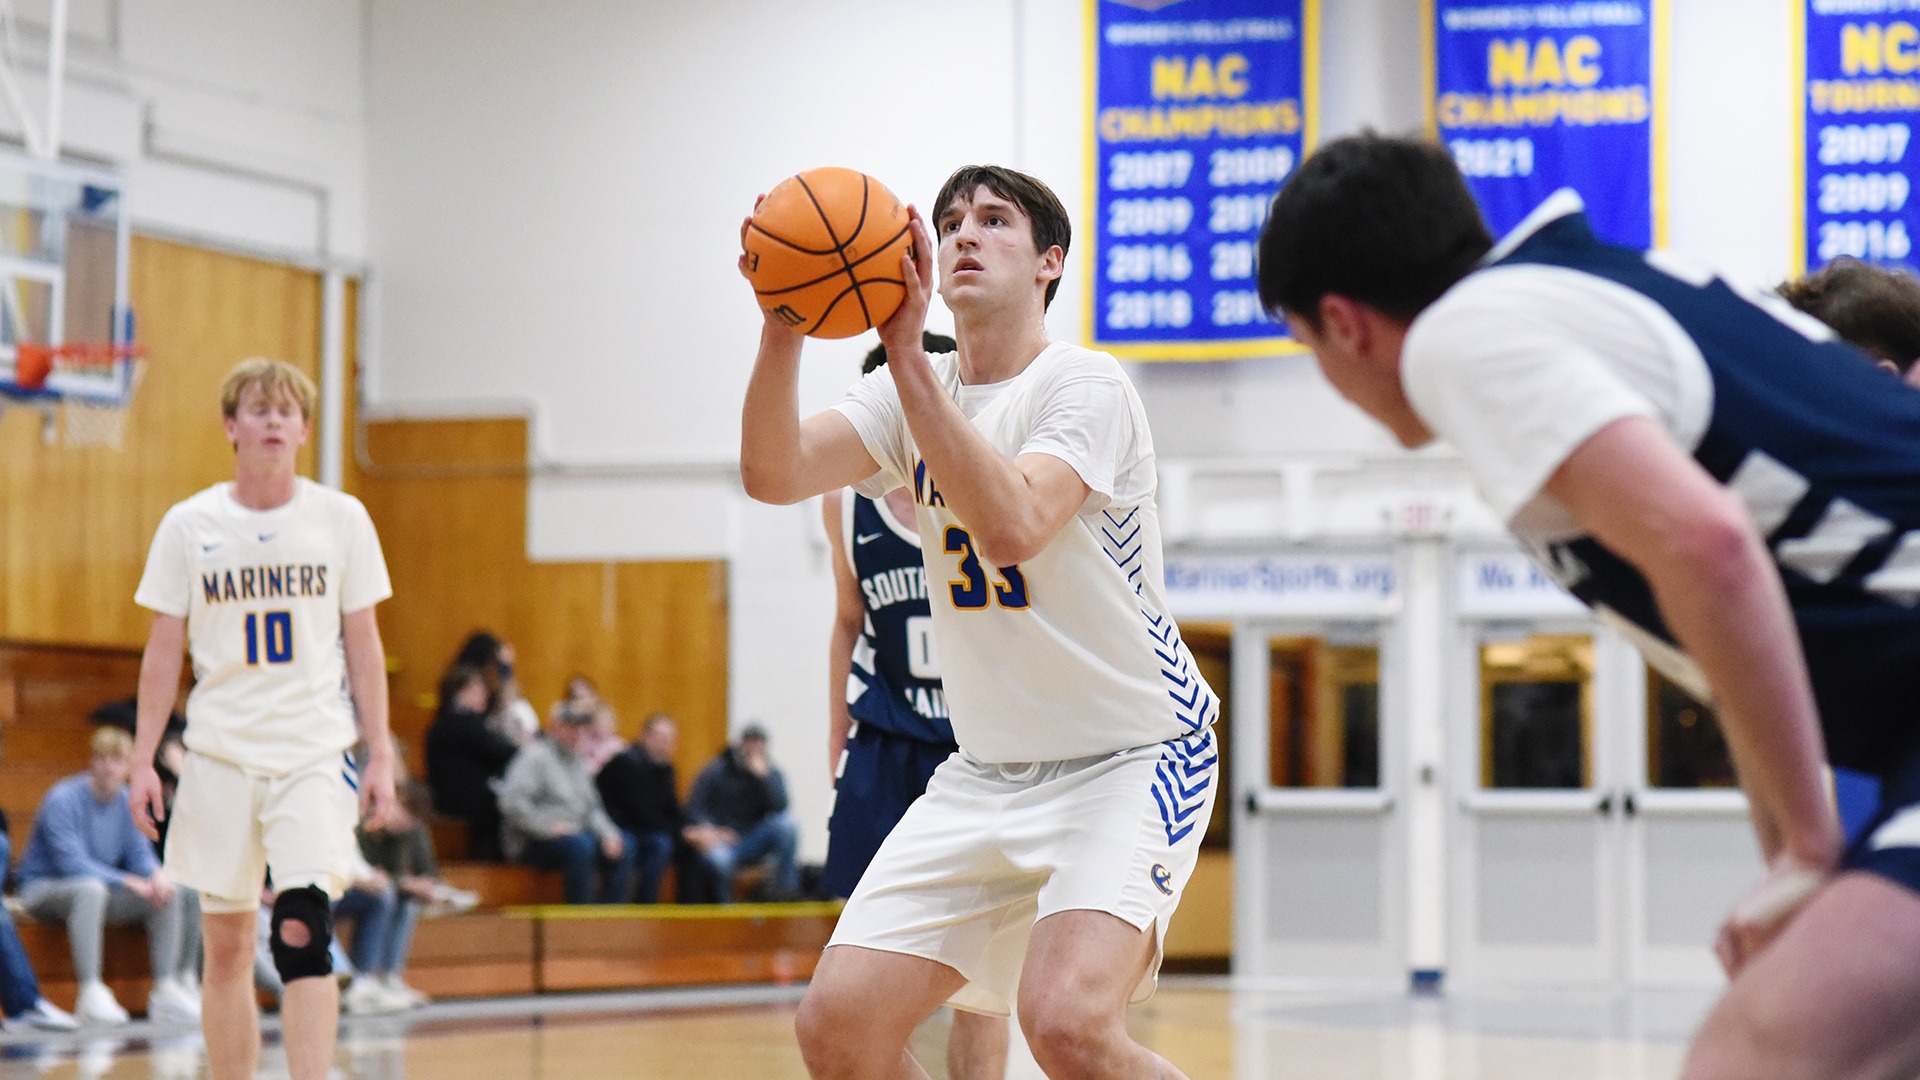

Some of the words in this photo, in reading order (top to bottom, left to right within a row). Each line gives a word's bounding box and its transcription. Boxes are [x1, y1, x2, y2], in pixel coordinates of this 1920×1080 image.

[1488, 35, 1602, 88] NAC
[1840, 21, 1920, 74] NC
[1152, 54, 1250, 99] NAC
[1101, 100, 1299, 143] CHAMPIONS
[1436, 86, 1649, 128] CHAMPIONS
[1818, 124, 1910, 165] 2007
[1109, 150, 1193, 190] 2007
[1818, 172, 1910, 213] 2009
[1108, 196, 1193, 237] 2009
[1817, 220, 1911, 260] 2016
[1107, 243, 1192, 282] 2016
[202, 564, 327, 605] MARINERS
[943, 524, 1031, 611] 33
[244, 610, 293, 665] 10
